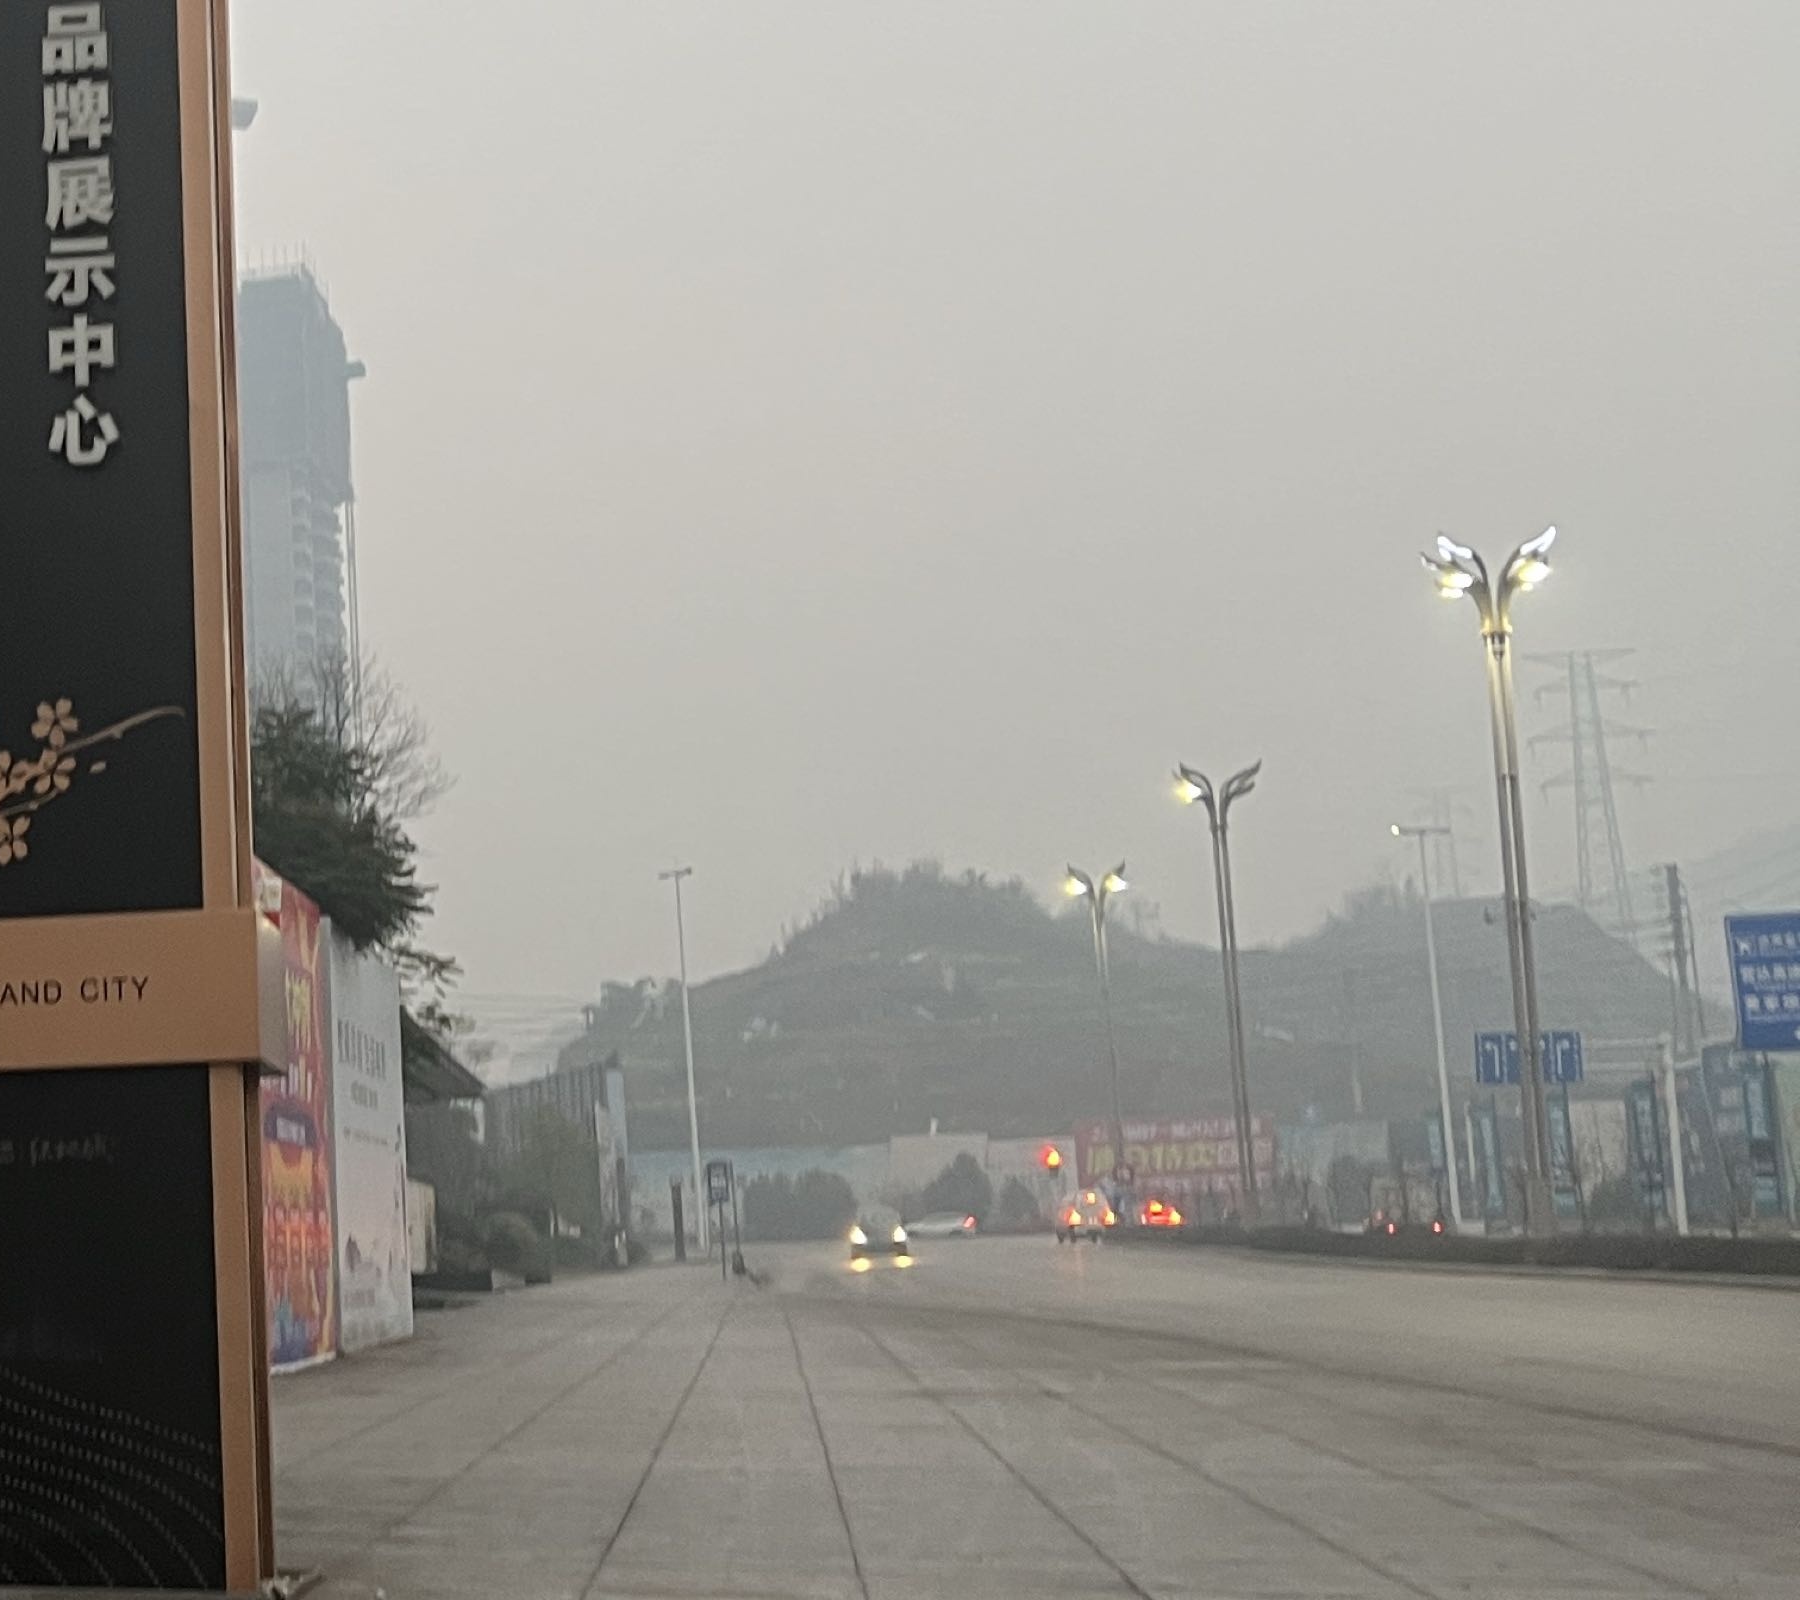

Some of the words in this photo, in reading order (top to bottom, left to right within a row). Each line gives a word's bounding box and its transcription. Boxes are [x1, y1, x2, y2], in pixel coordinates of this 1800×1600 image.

[41, 2, 120, 466] 品牌展示中心
[79, 974, 149, 1004] CITY
